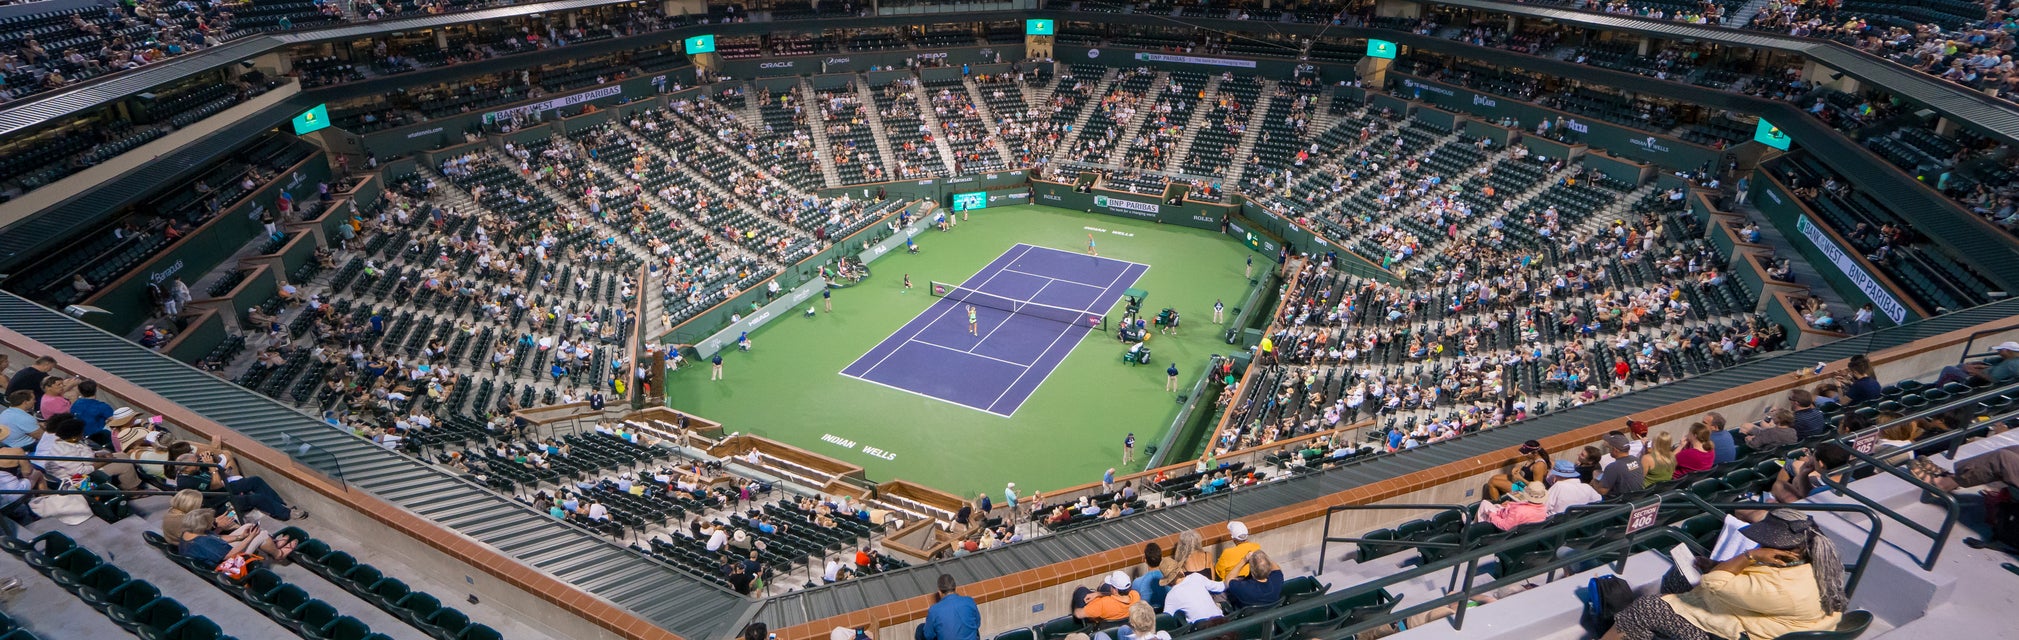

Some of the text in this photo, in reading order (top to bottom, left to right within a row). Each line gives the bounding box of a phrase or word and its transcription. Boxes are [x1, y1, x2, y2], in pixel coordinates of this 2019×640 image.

[530, 101, 554, 112] WEST
[565, 95, 584, 105] BNP
[585, 86, 619, 100] PARIBAS
[1629, 138, 1647, 146] INDIAN
[1653, 144, 1669, 152] WELLS
[1126, 201, 1156, 211] PARIBAS
[1288, 222, 1299, 232] FILA
[874, 245, 887, 255] FILA
[154, 260, 184, 284] Barracuda
[1804, 221, 1822, 245] BANK
[1823, 241, 1843, 264] WEST
[1848, 264, 1867, 285] BNP
[1865, 280, 1903, 322] PARIBAS
[748, 311, 770, 326] HEAD
[821, 433, 897, 460] INDIAN WELLS
[1856, 436, 1875, 446] SECTION
[1856, 442, 1872, 453] 405
[1633, 507, 1657, 518] SECTION
[1631, 514, 1653, 529] 406
